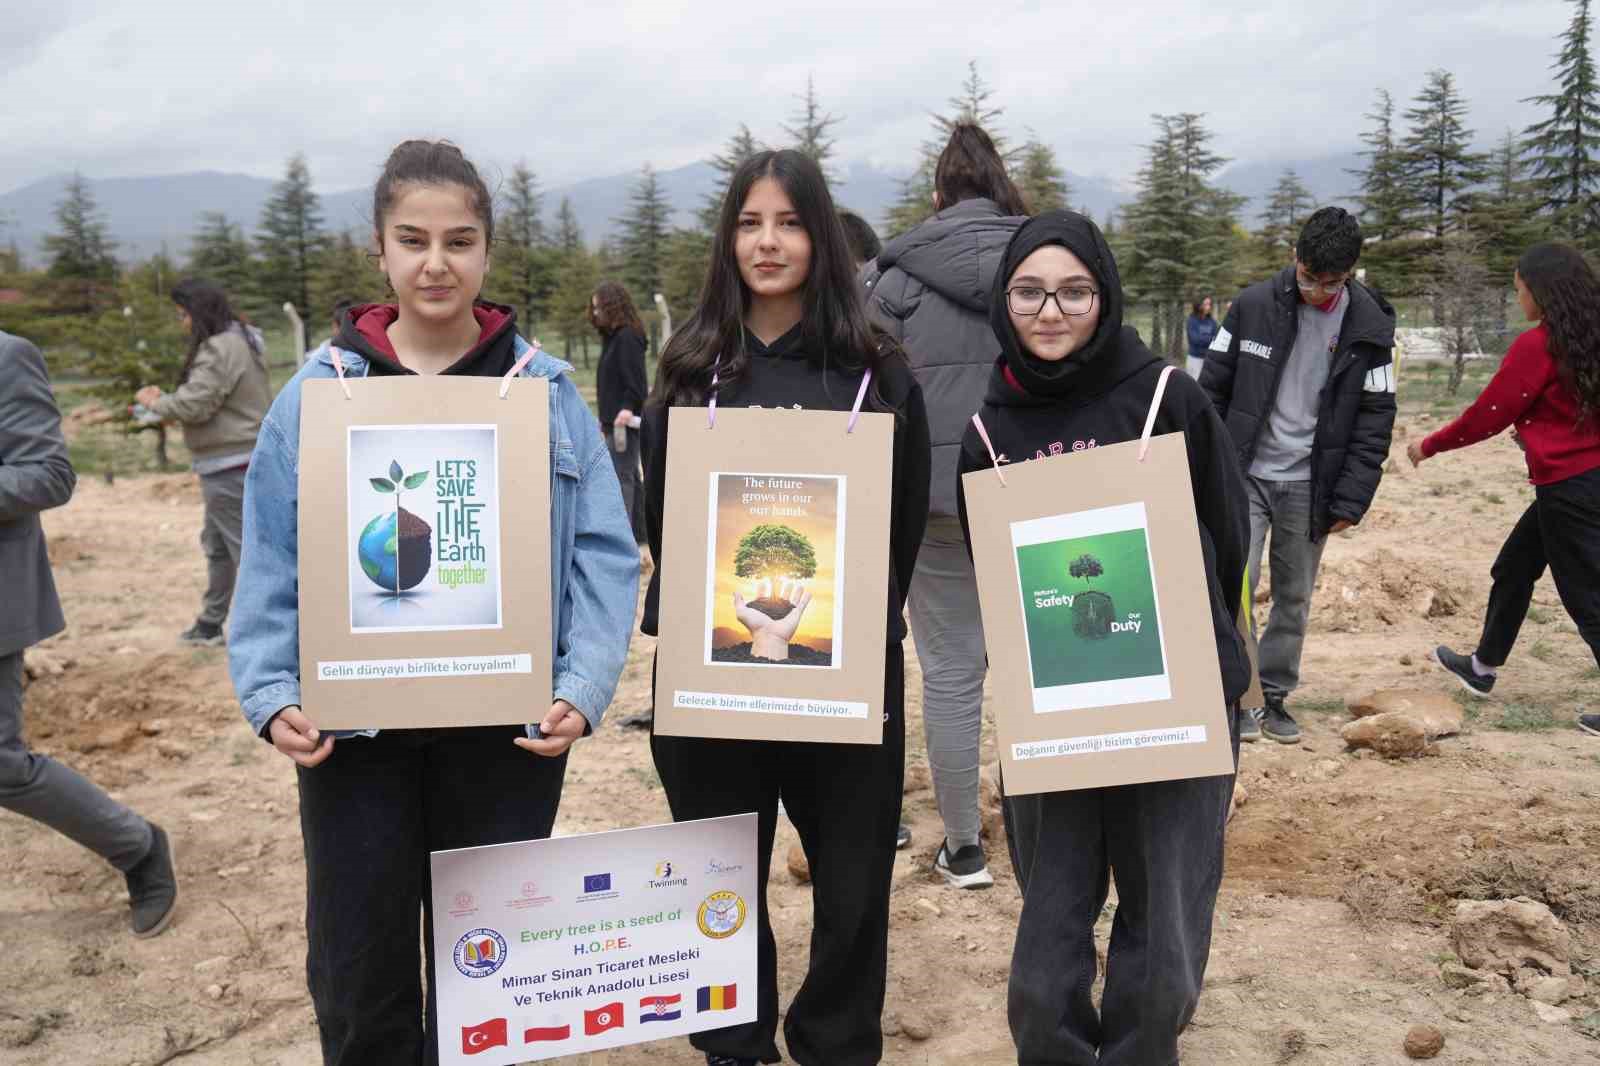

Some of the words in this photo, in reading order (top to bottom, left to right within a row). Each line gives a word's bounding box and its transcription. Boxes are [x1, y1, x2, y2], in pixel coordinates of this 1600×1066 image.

[436, 460, 476, 478] LET'S
[436, 479, 475, 496] SAVE
[743, 477, 764, 488] The
[768, 478, 803, 489] future
[742, 492, 775, 504] grows
[779, 492, 790, 503] in
[793, 494, 812, 503] our
[750, 505, 769, 515] our
[772, 504, 807, 516] hands.
[437, 497, 485, 542] THE
[438, 538, 485, 561] Earth
[438, 563, 486, 589] together
[1036, 595, 1074, 608] Safety
[1111, 621, 1141, 632] Duty
[323, 665, 353, 677] Gelin
[356, 662, 404, 677] dünyayı
[408, 661, 449, 674] birlikte
[453, 659, 516, 674] koruyalım!
[678, 695, 717, 707] Gelecek
[719, 697, 746, 709] bizim
[750, 699, 804, 712] ellerimizde
[1016, 742, 1055, 757] Doğanın
[1058, 739, 1102, 752] güvenliği
[1105, 736, 1131, 747] bizim
[1135, 731, 1190, 746] görevimiz!
[649, 878, 687, 888] Twinning
[521, 929, 563, 943] Every
[568, 923, 595, 936] tree
[599, 920, 613, 931] is
[617, 921, 625, 929] a
[630, 912, 662, 926] seed
[668, 909, 682, 921] of
[574, 938, 632, 955] H.O.P.E.
[503, 973, 546, 989] Mimar
[552, 967, 592, 981] Sinan
[597, 959, 644, 975] Ticaret
[649, 948, 699, 966] Mesleki
[514, 995, 531, 1006] Ve
[536, 984, 582, 1003] Teknik
[587, 978, 645, 994] Anadolu
[650, 970, 689, 986] Lisesi
